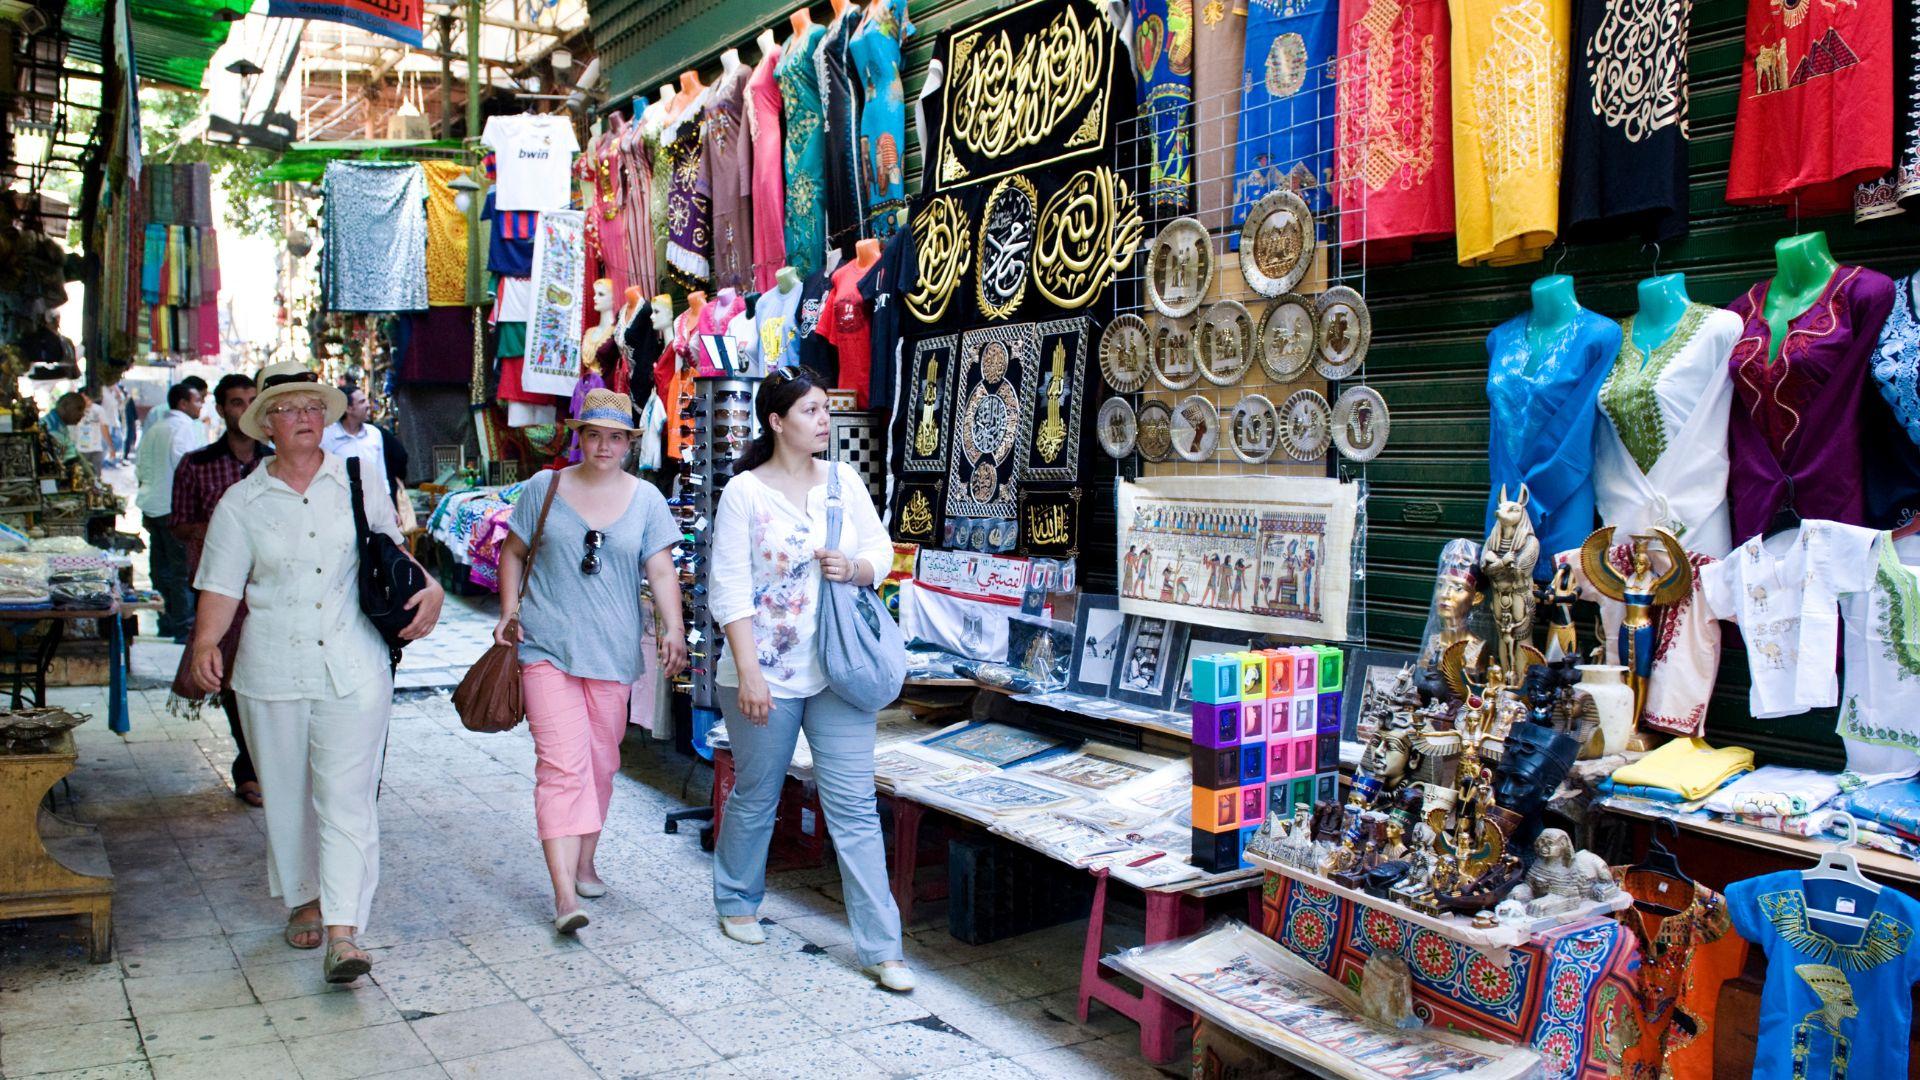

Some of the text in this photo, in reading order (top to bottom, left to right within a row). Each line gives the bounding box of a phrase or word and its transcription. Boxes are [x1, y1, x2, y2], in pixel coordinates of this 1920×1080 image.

[518, 148, 549, 160] bwin
[981, 221, 1030, 297] محمد
[976, 562, 1028, 592] القصبجي
